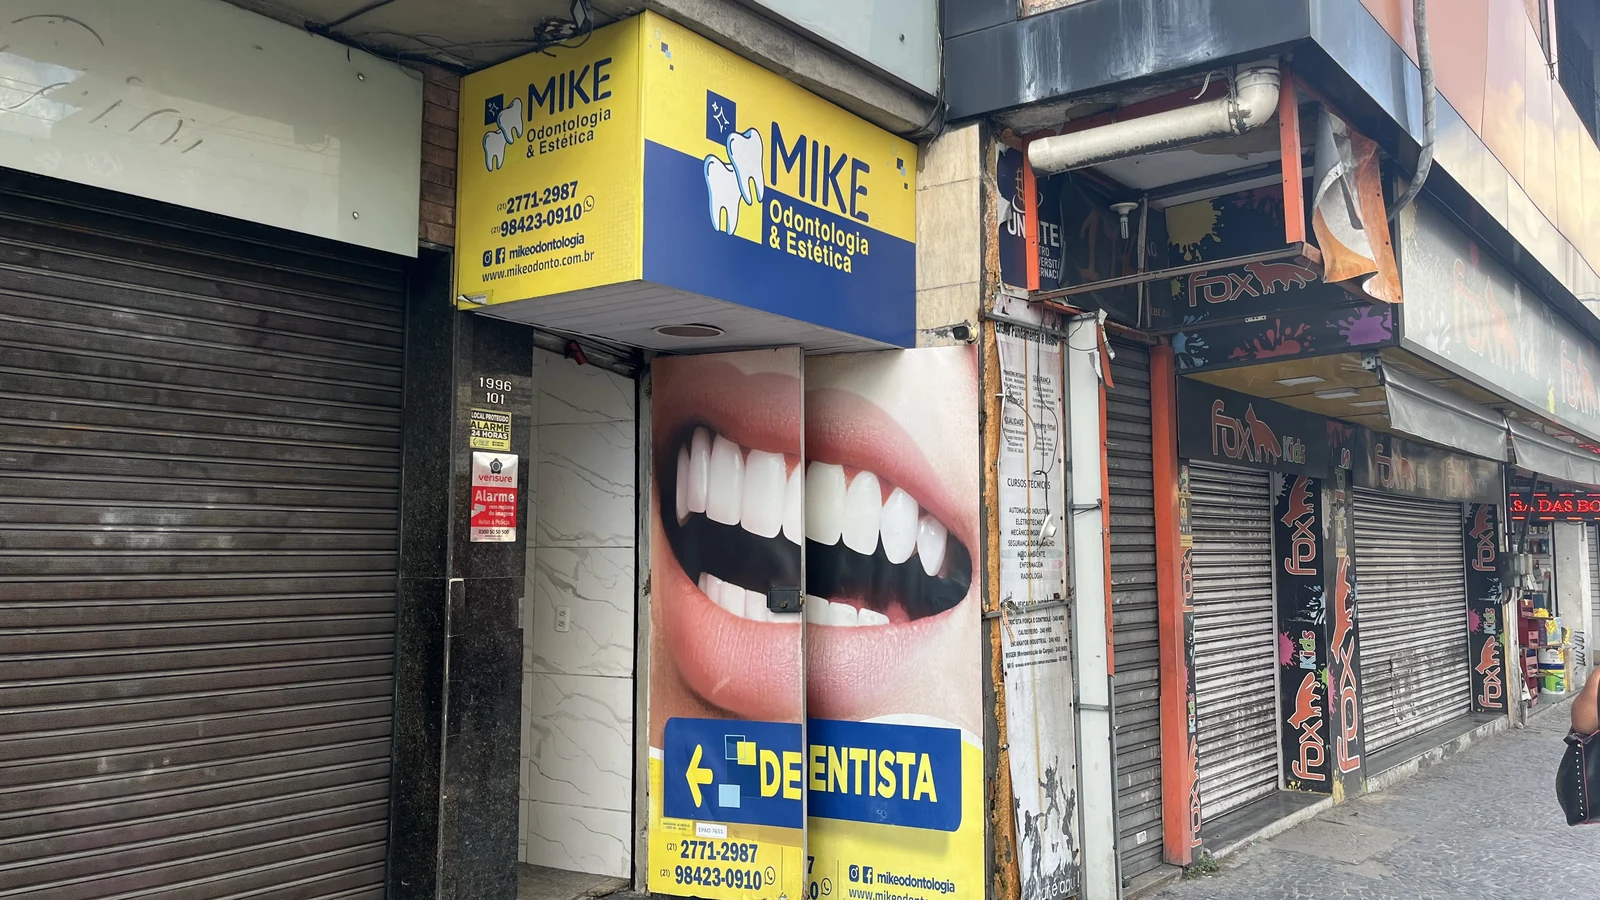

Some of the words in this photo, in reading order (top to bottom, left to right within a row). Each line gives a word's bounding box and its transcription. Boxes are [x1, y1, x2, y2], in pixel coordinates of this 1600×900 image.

[527, 57, 612, 122] MIKE
[526, 108, 611, 143] Odontologia
[526, 145, 535, 158] &
[539, 129, 594, 155] Estética
[770, 121, 870, 223] MIKE
[506, 180, 578, 214] 2771-2987
[500, 203, 582, 237] 98423-0910
[769, 199, 869, 256] Odontologia
[509, 233, 585, 260] mikeodontologia
[769, 225, 781, 250] &
[786, 231, 852, 274] Estética
[482, 250, 595, 282] www.mikeodonto.com.br
[479, 376, 512, 392] 1996
[486, 392, 505, 405] 101
[470, 421, 510, 433] ALARME
[471, 411, 486, 420] LOCAL
[485, 413, 509, 423] PROTEGIDO
[471, 429, 481, 437] 24
[482, 431, 508, 439] HORAS
[1282, 435, 1306, 465] Kids
[478, 474, 513, 482] verisure
[1007, 478, 1027, 488] CURSOS
[475, 489, 515, 503] Alarme
[1538, 499, 1574, 512] DAS
[1577, 499, 1600, 513] BO
[1009, 507, 1031, 515] AUTOMAÇÃO
[1483, 607, 1497, 635] Kids
[1299, 629, 1317, 670] Kids
[809, 744, 938, 803] ENTISTA
[667, 843, 677, 852] (21)
[680, 839, 758, 864] 2771-2987
[660, 868, 671, 877] (21)
[675, 865, 763, 891] 98423-0910
[877, 872, 956, 894] mikeodontologia
